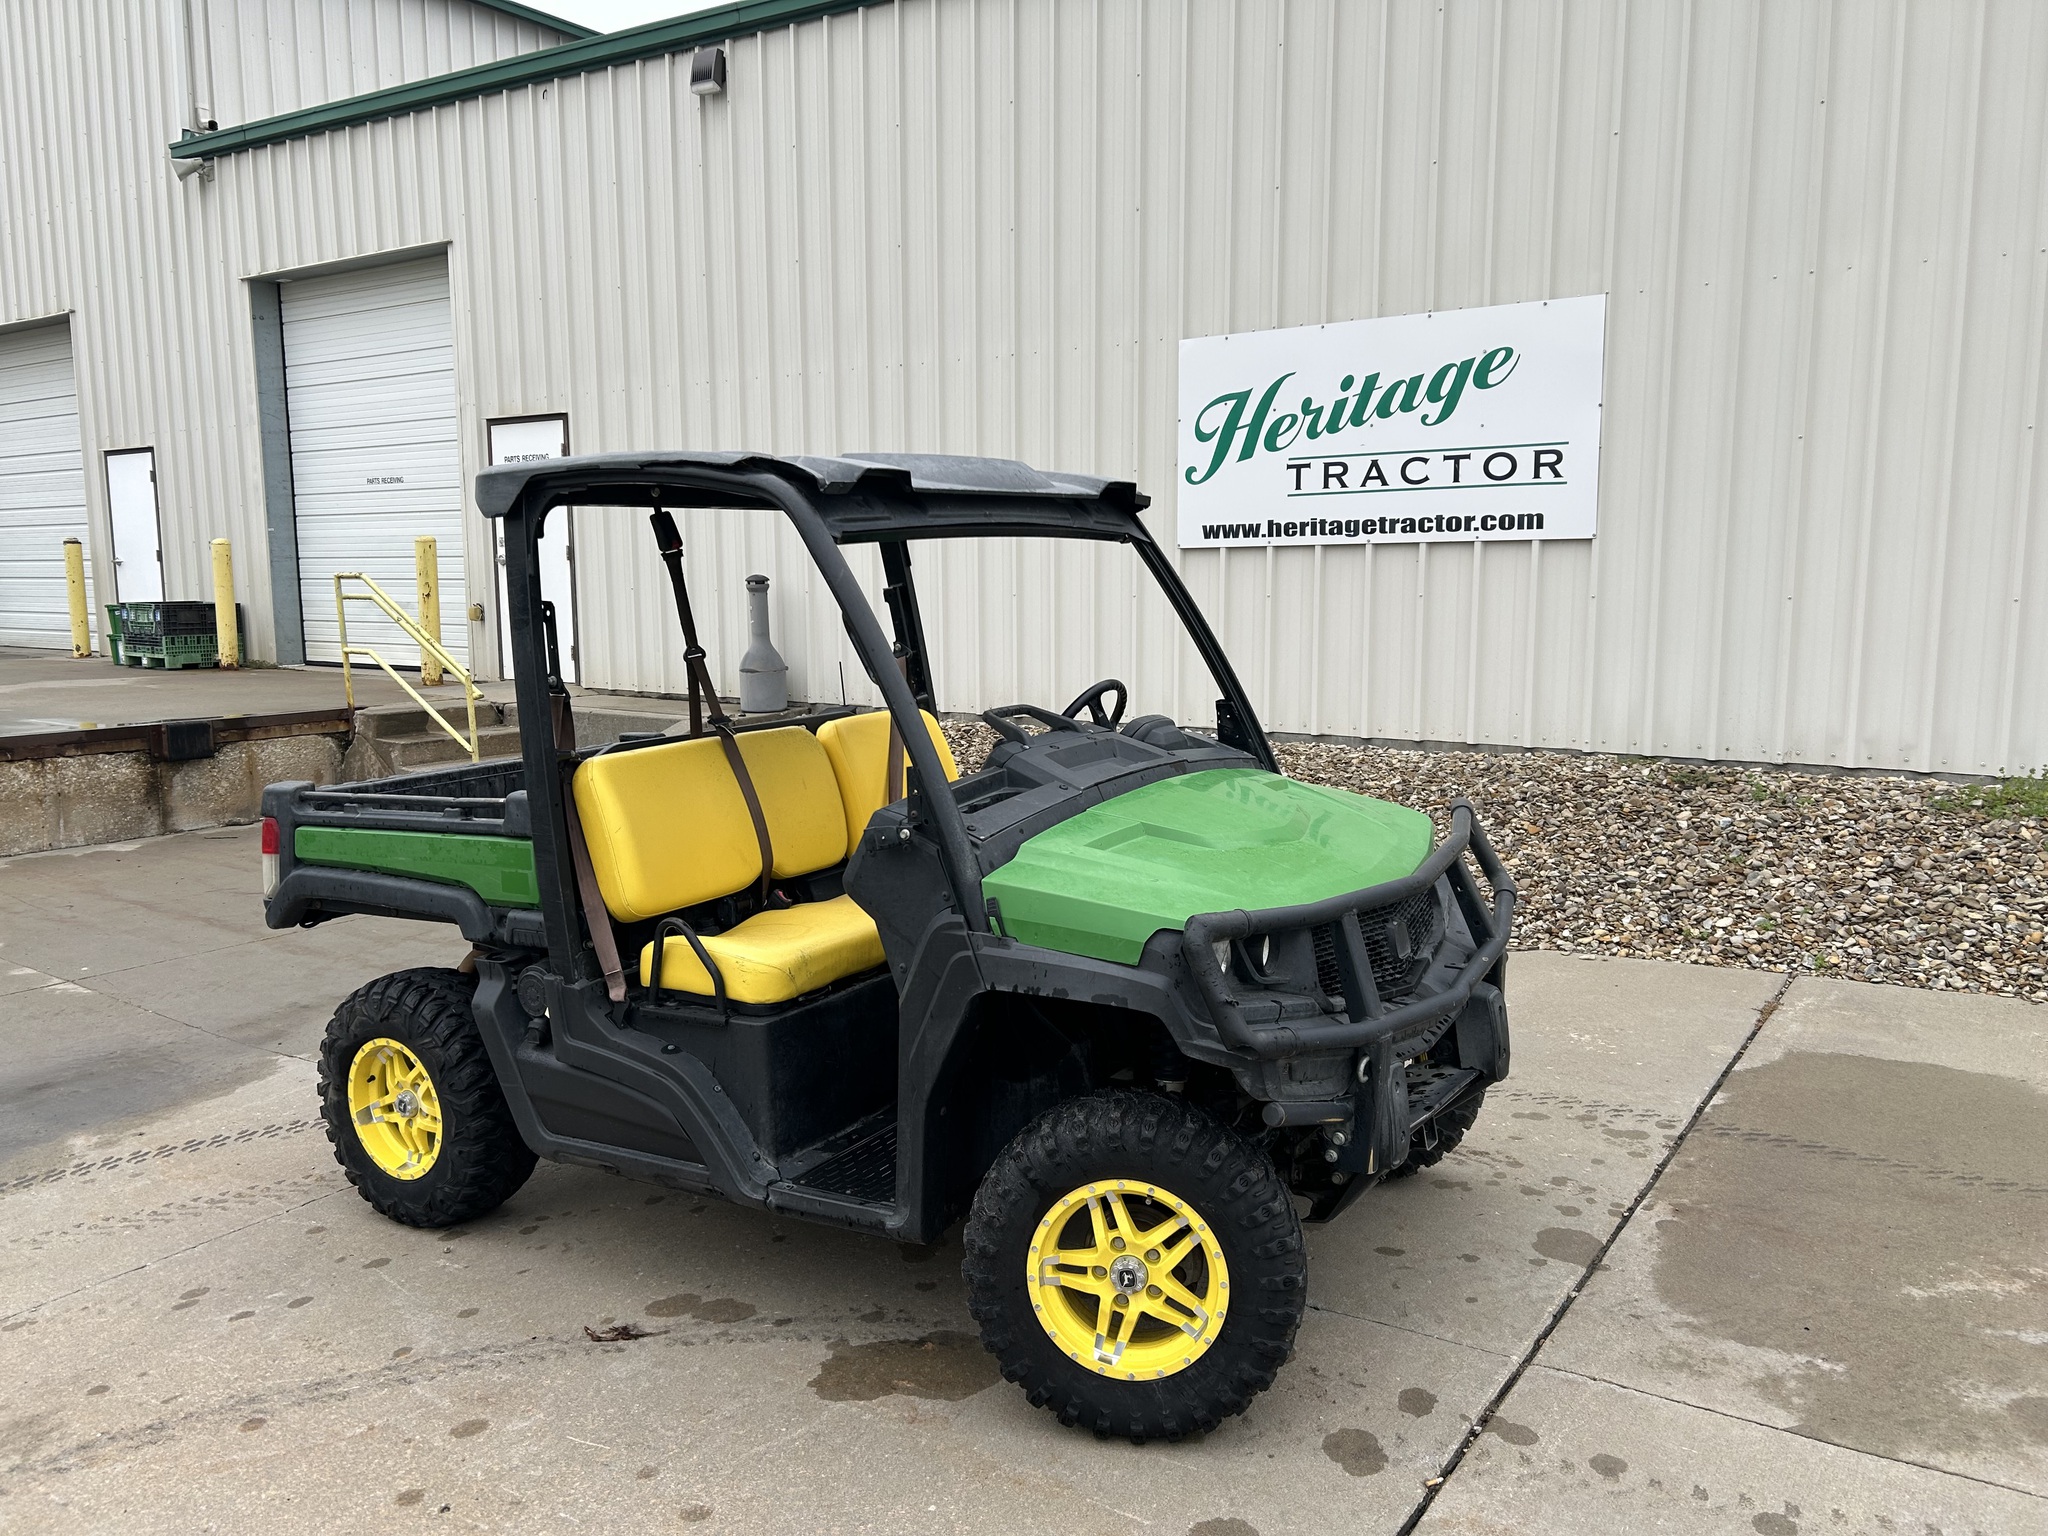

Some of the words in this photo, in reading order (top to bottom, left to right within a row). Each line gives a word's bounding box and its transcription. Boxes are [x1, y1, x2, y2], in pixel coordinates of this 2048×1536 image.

[1185, 346, 1521, 486] Heritage
[504, 455, 520, 463] PARTS
[1286, 449, 1564, 491] TRACTOR
[366, 477, 380, 485] PARTS
[1202, 512, 1545, 540] www.heritagetractor.com
